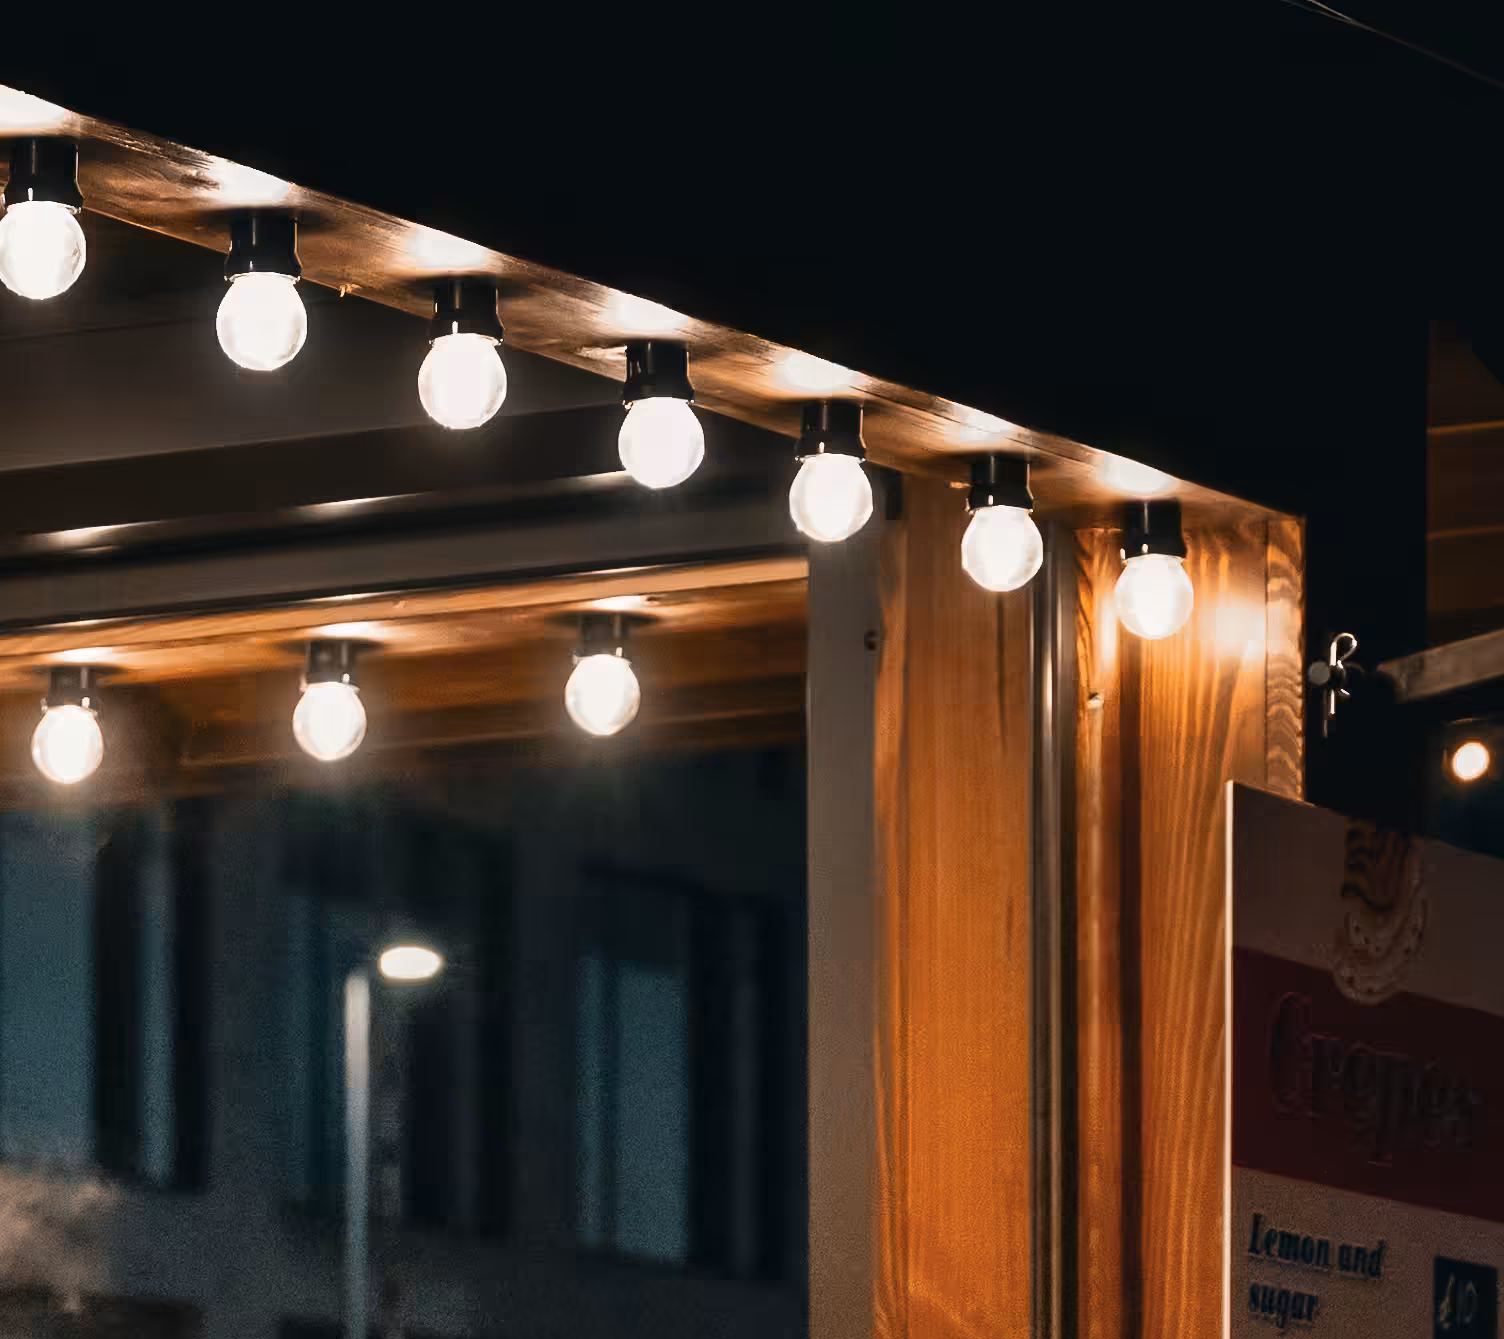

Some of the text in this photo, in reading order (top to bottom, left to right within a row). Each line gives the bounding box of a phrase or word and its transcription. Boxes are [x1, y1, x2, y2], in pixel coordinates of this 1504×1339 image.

[1270, 992, 1482, 1166] Crepes
[1249, 1213, 1385, 1277] Lemon and
[1249, 1283, 1317, 1335] sugar
